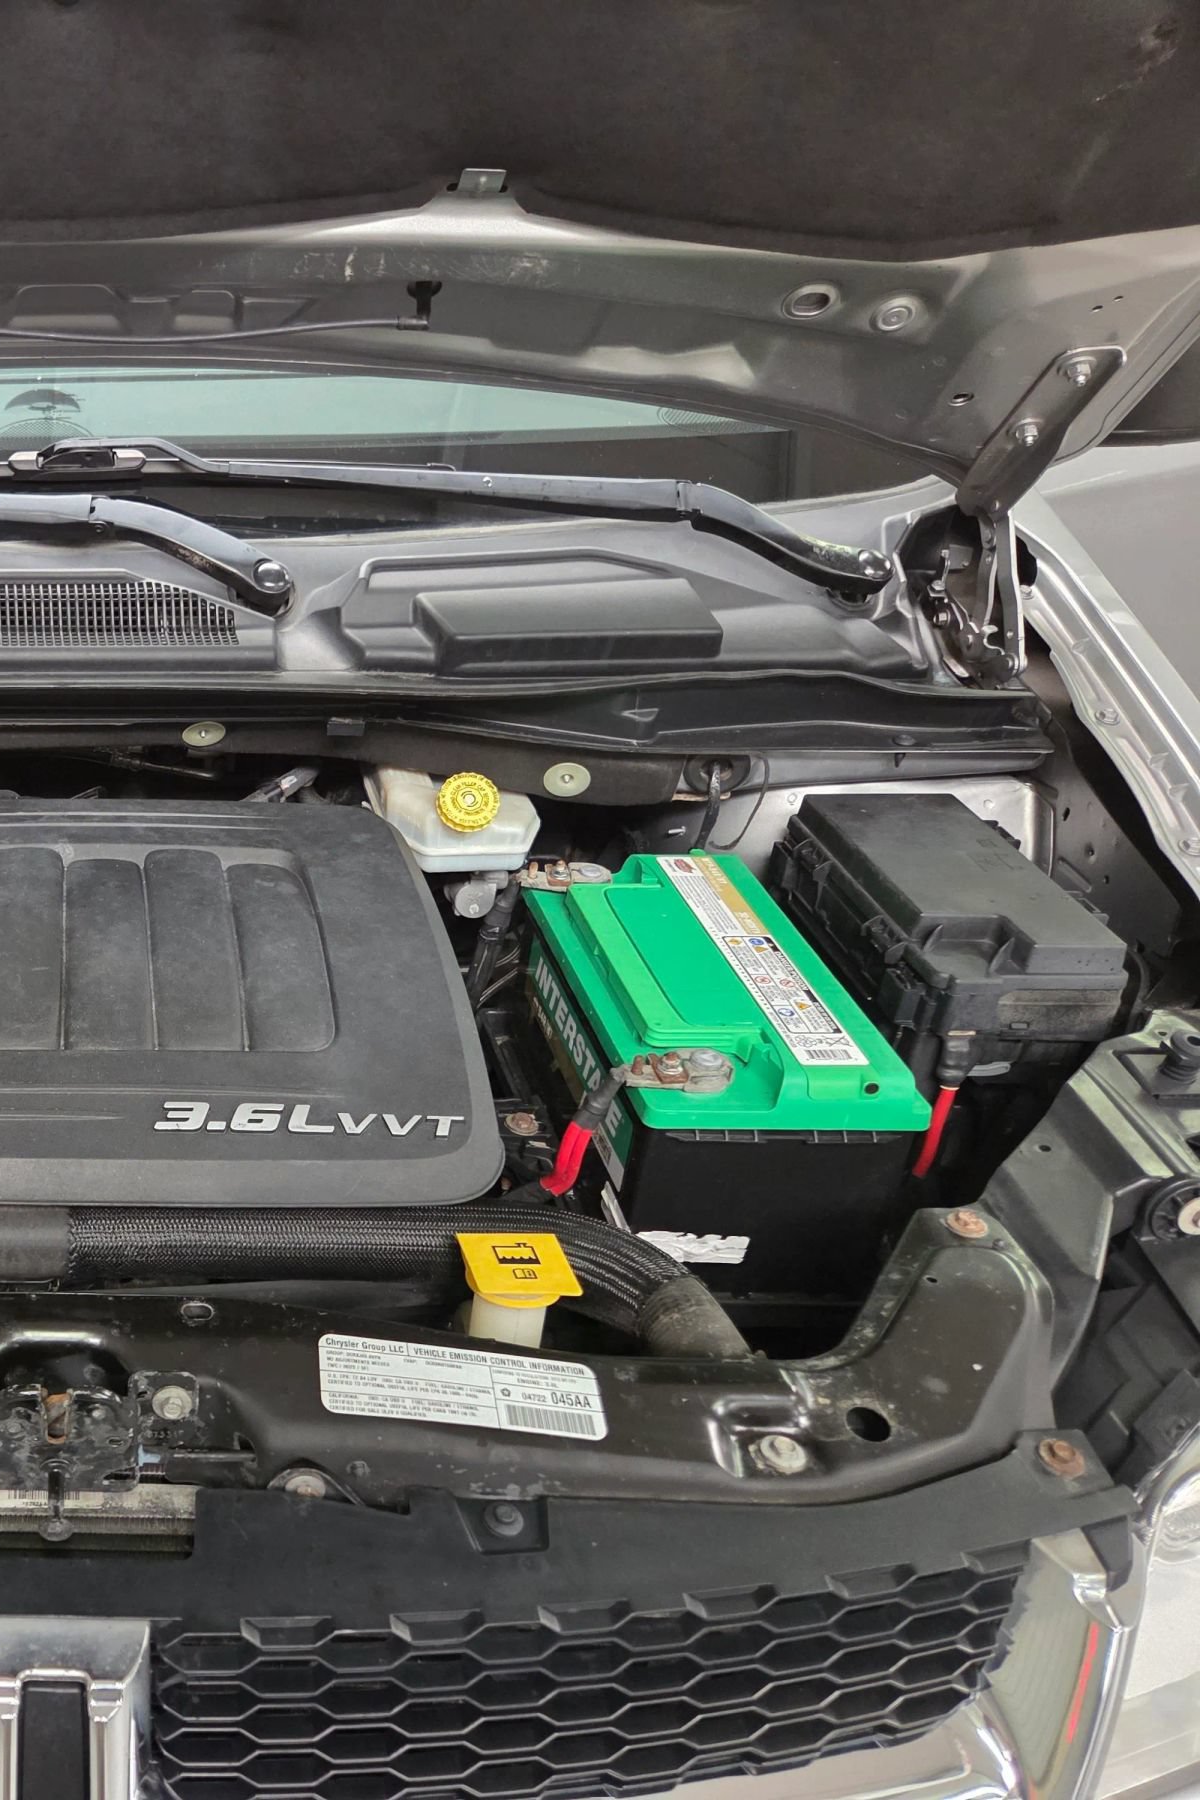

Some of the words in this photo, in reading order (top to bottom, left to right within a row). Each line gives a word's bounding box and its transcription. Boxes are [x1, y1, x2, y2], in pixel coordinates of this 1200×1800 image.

[535, 957, 622, 1139] INTERSTAE
[153, 1101, 335, 1134] 3.6L
[336, 1112, 465, 1137] VVT
[325, 1337, 359, 1349] Chrysler
[361, 1341, 385, 1352] Group
[388, 1344, 404, 1353] LLC
[413, 1347, 447, 1358] VEHICLE
[448, 1351, 487, 1363] EMISSION
[489, 1356, 525, 1368] CONTROL
[528, 1361, 584, 1375] INFORMATION
[522, 1392, 547, 1403] 04722
[551, 1392, 592, 1409] 045AA
